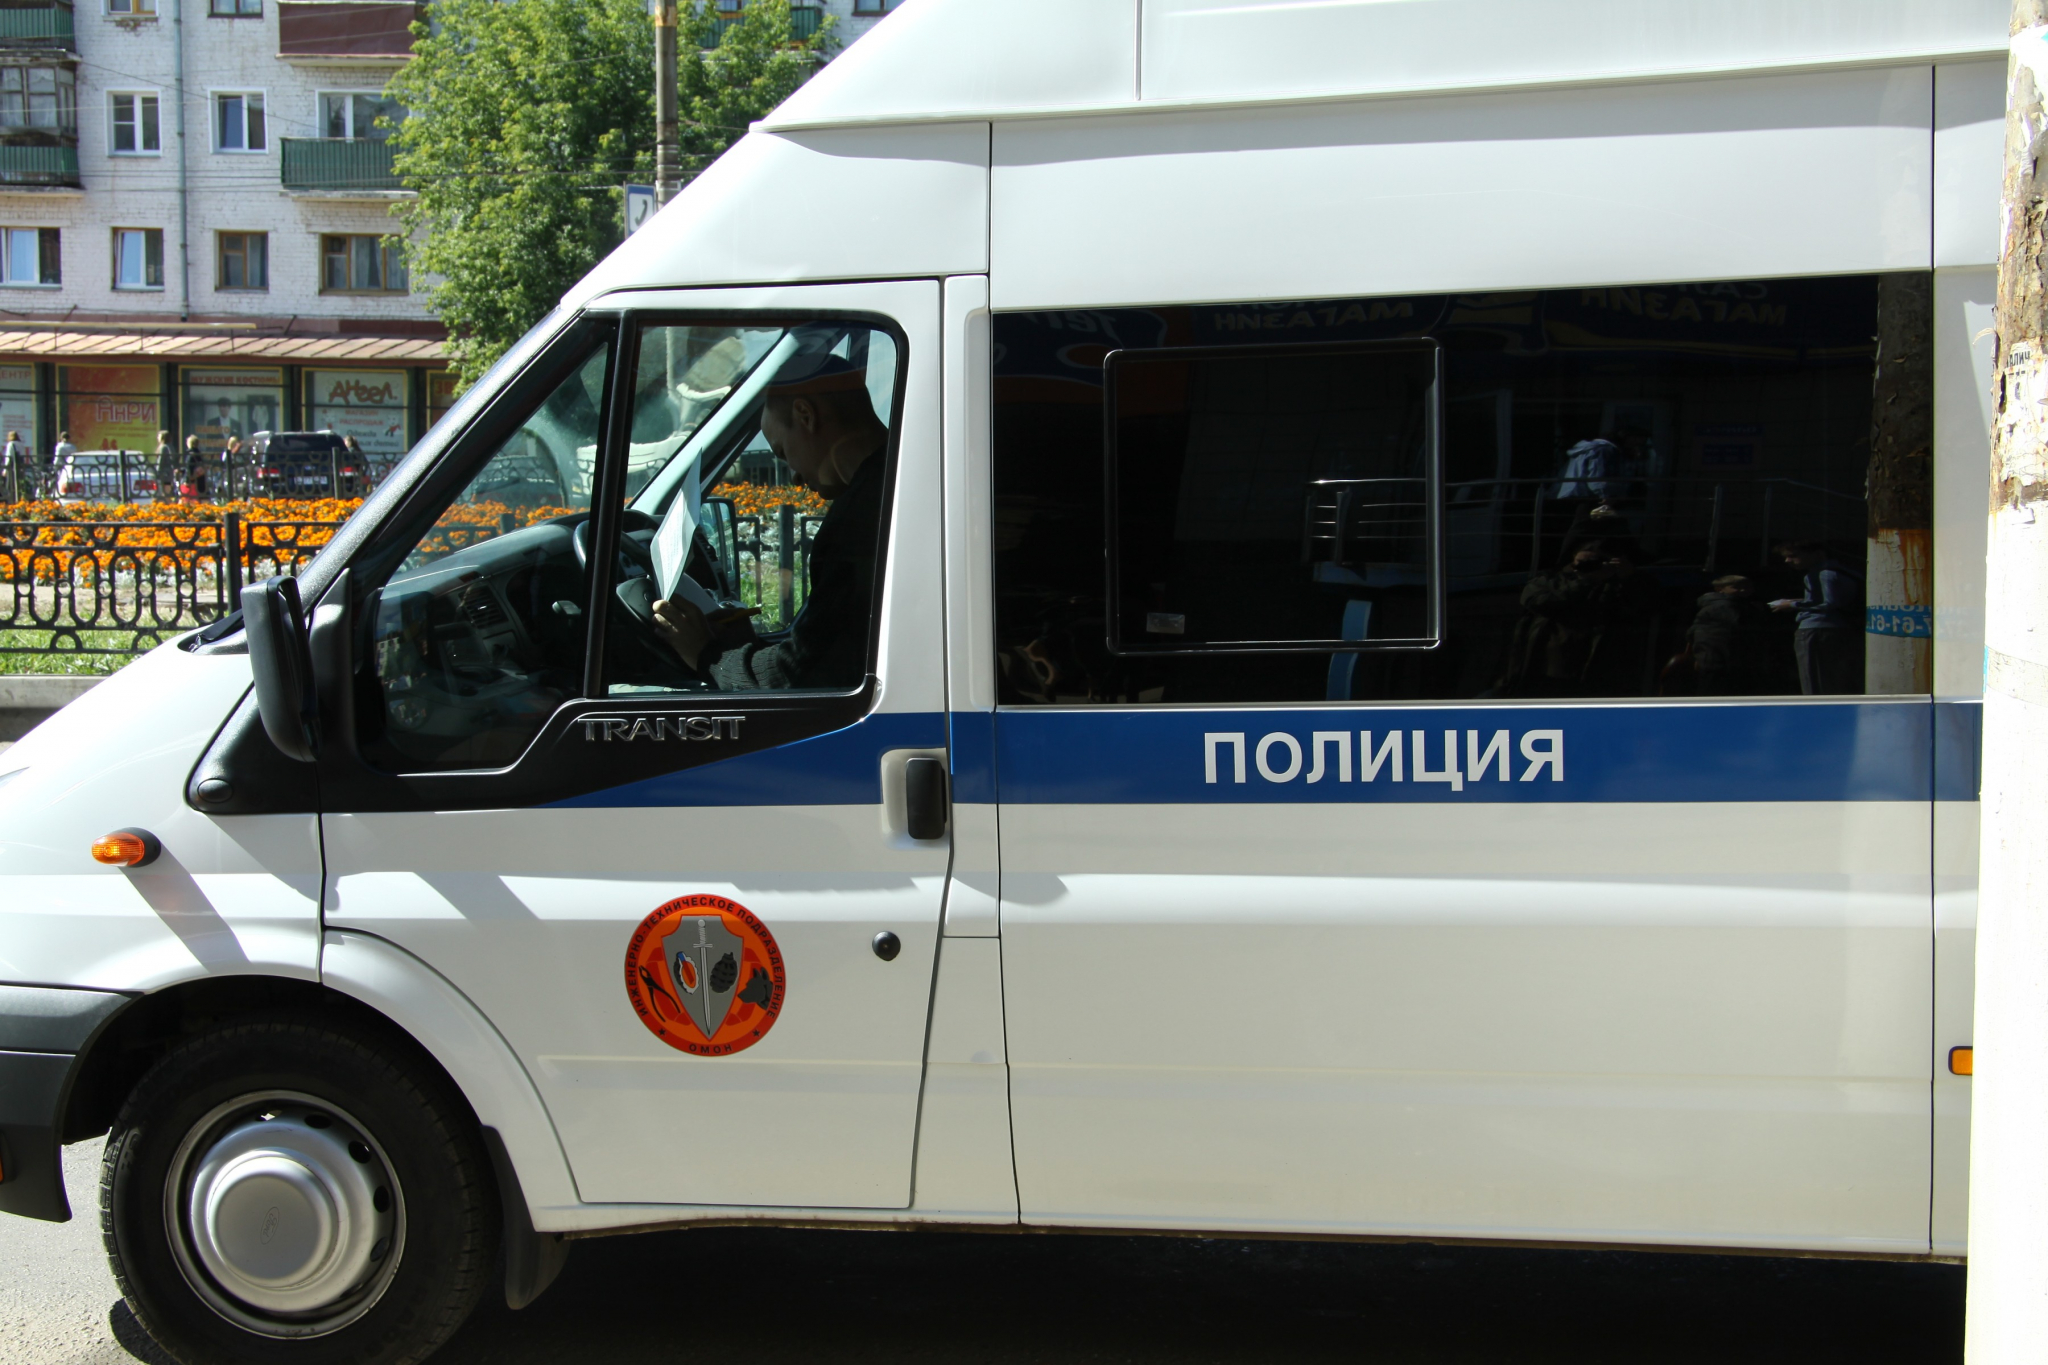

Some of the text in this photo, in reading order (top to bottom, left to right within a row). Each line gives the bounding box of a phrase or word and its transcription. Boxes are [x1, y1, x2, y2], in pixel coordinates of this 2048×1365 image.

[577, 715, 746, 742] TRANSIT
[1204, 729, 1564, 792] ПОЛИЦИЯ
[625, 896, 784, 1019] ИНЖЕНЕРНО-ТЕХНИЧЕСКОЕ ПОДРАЗДЕЛЕНИЕ
[688, 1043, 733, 1054] ОМОН
[262, 1211, 278, 1239] Ford
